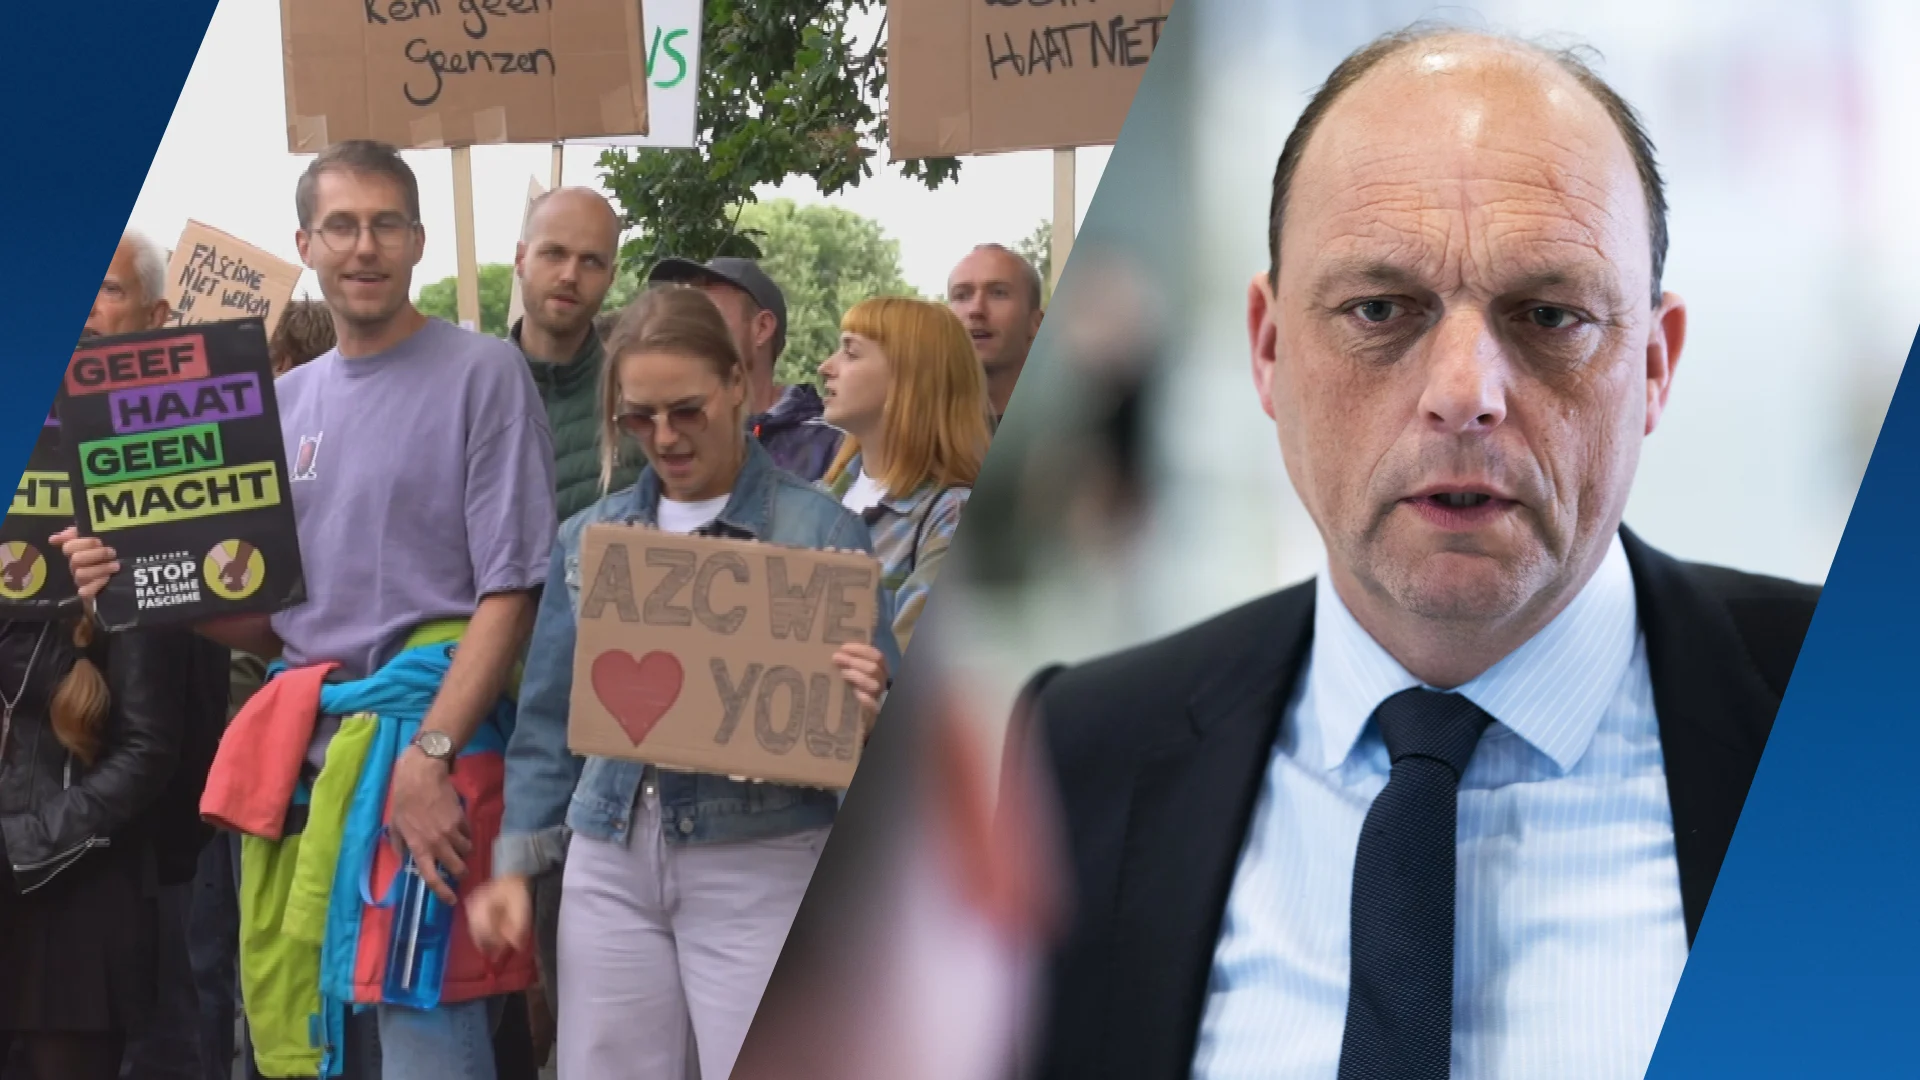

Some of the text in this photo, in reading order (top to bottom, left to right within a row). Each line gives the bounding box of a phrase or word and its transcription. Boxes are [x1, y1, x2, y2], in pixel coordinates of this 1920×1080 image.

[985, 15, 1168, 80] HAAT NIET
[73, 342, 195, 387] GEEF
[120, 380, 253, 428] HAAT
[86, 431, 217, 477] GEEN
[93, 469, 272, 523] MACHT
[134, 561, 196, 586] STOP
[136, 578, 199, 598] RACISME
[581, 543, 871, 644] AZC WE
[138, 591, 201, 610] FASCISME
[709, 656, 861, 761] YOU
